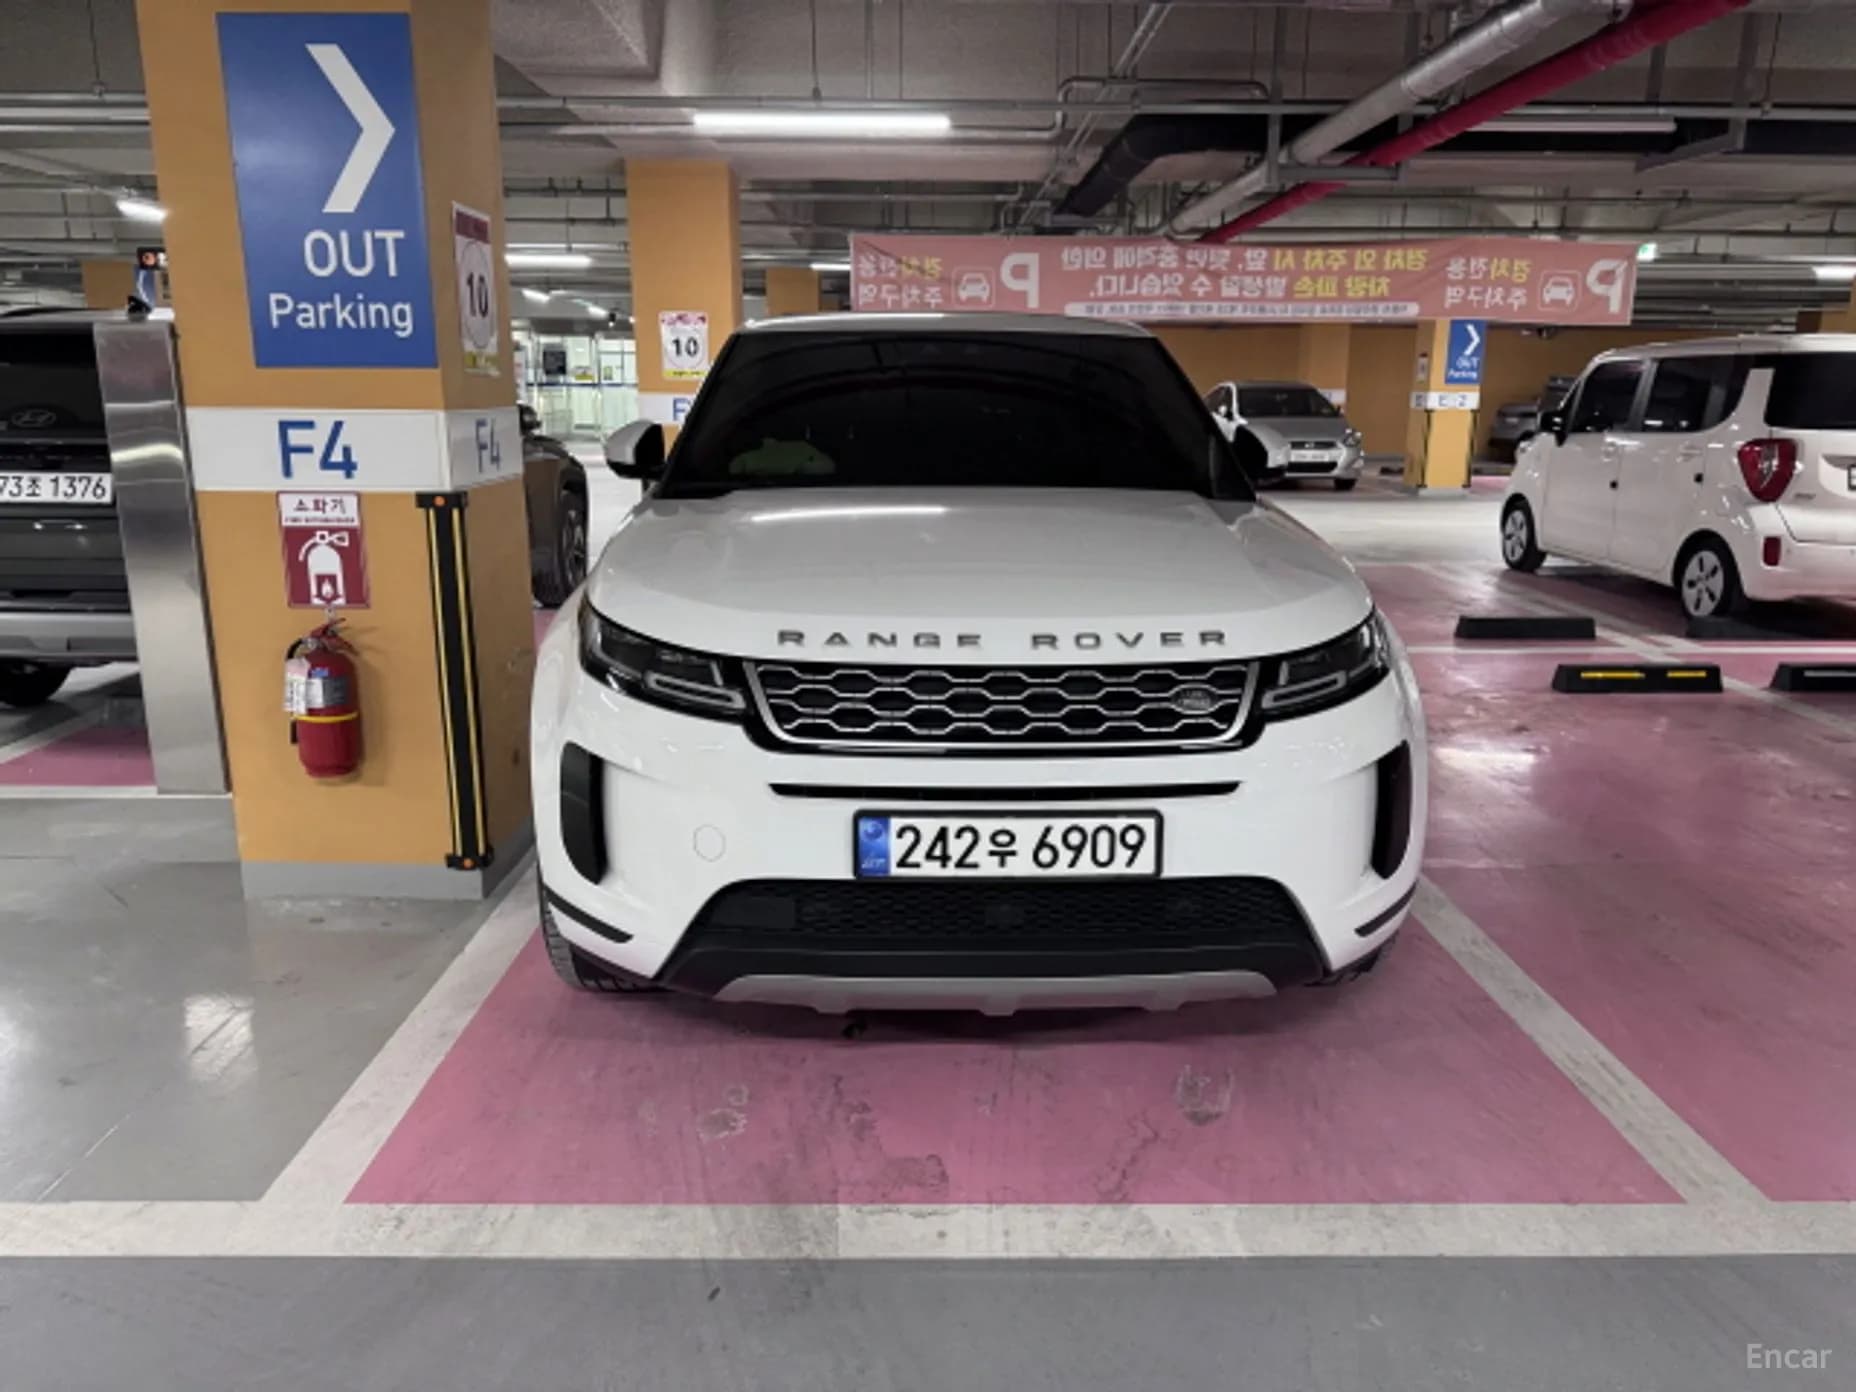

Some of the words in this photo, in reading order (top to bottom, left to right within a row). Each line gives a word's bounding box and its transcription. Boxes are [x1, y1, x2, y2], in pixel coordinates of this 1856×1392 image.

[304, 229, 405, 277] OUT
[269, 292, 413, 338] Parking
[466, 271, 489, 319] 10
[671, 336, 699, 357] 10
[672, 397, 692, 421] F
[279, 420, 358, 479] F4
[475, 418, 501, 473] F4
[49, 475, 106, 499] 1376
[294, 498, 346, 515] 소화기
[777, 630, 981, 649] RANGE
[1031, 630, 1227, 650] ROVER
[895, 824, 1017, 869] 242우
[1032, 823, 1146, 869] 6909
